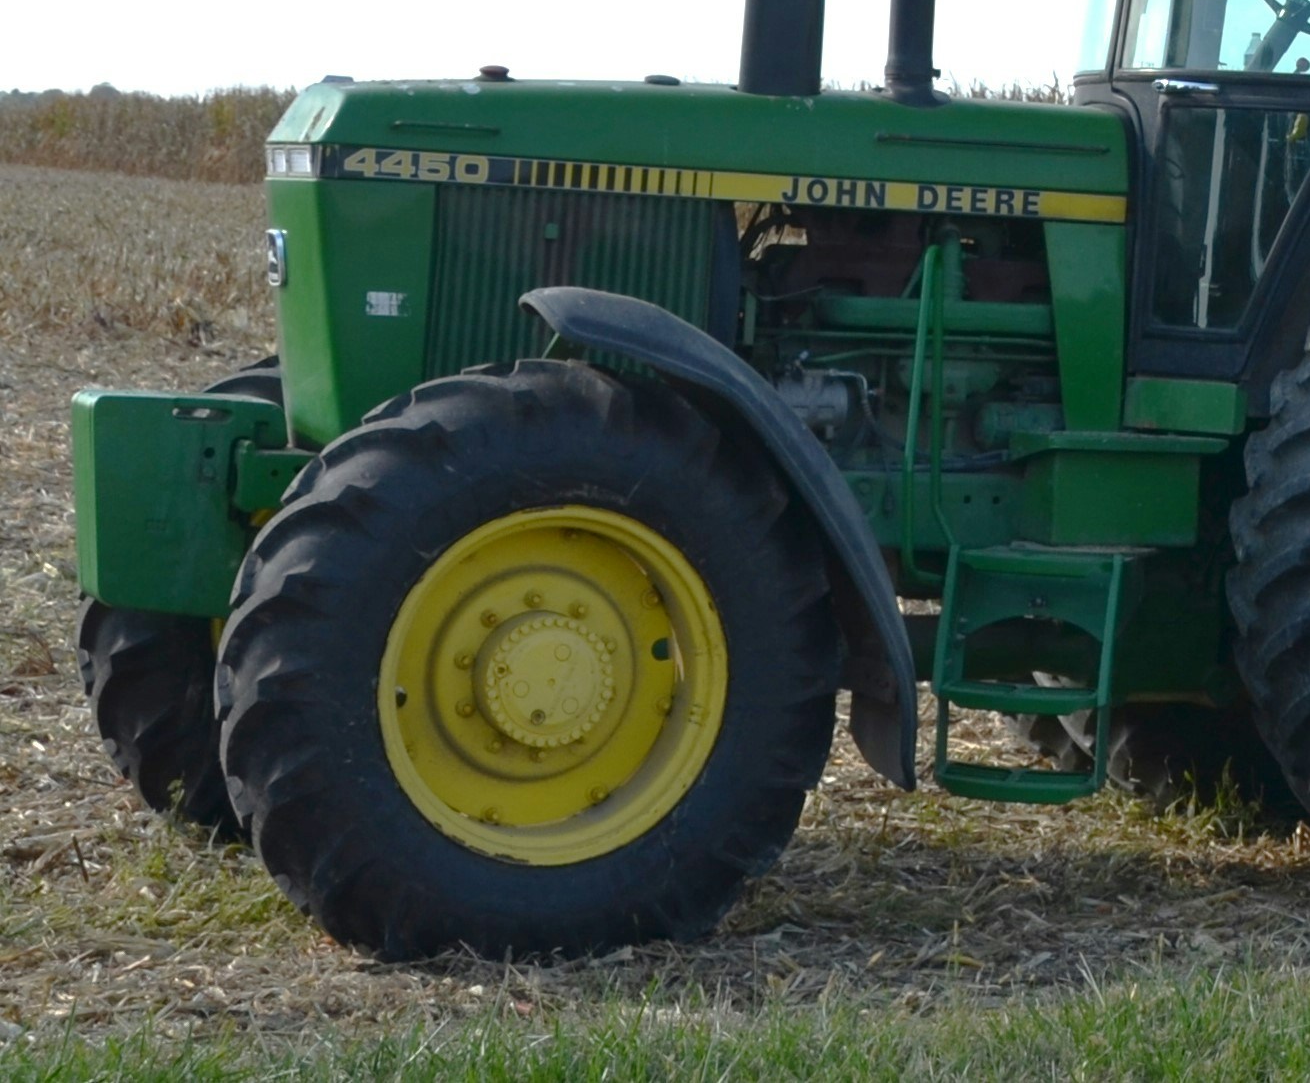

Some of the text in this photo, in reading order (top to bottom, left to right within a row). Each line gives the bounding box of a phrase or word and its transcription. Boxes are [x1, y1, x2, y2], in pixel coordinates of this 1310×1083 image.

[344, 148, 489, 183] 4450
[782, 177, 1041, 216] JOHN DEERE
